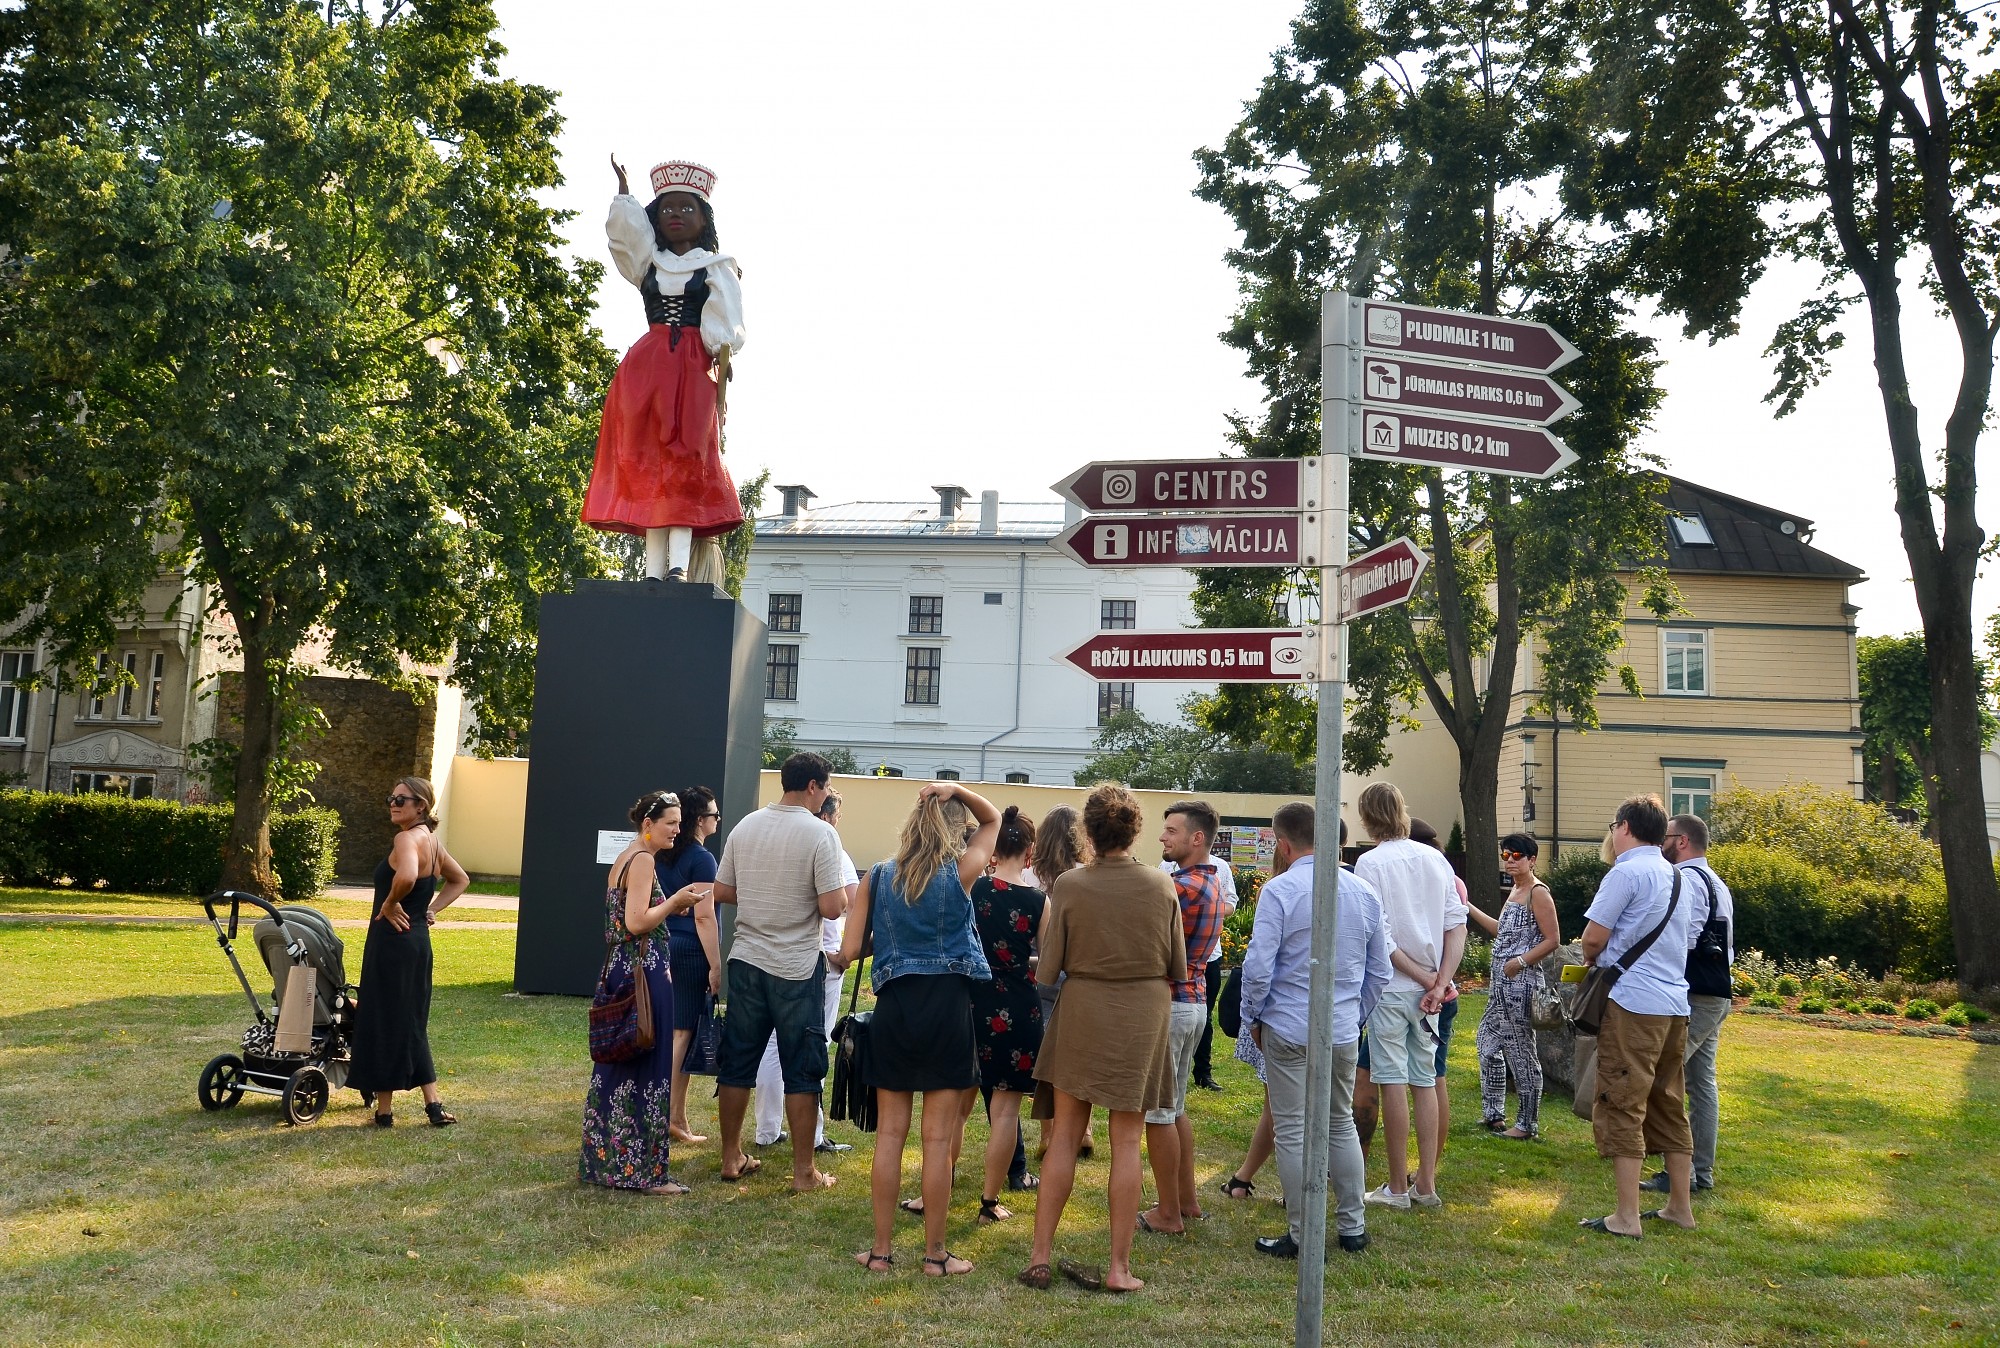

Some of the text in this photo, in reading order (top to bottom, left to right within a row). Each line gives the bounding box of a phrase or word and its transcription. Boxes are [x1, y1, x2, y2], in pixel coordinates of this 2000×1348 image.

[1406, 320, 1515, 352] PLUDMALE 1 km
[1404, 374, 1544, 408] JŪRMALAS PARKS 0,6 km
[1404, 426, 1510, 457] MUZEJS 0,2 km
[1154, 469, 1268, 501] CENTRS
[1138, 524, 1289, 554] INFMĀCIJA
[1400, 557, 1413, 582] km
[1091, 646, 1264, 668] ROŽU LAUKUMS 0,5 km
